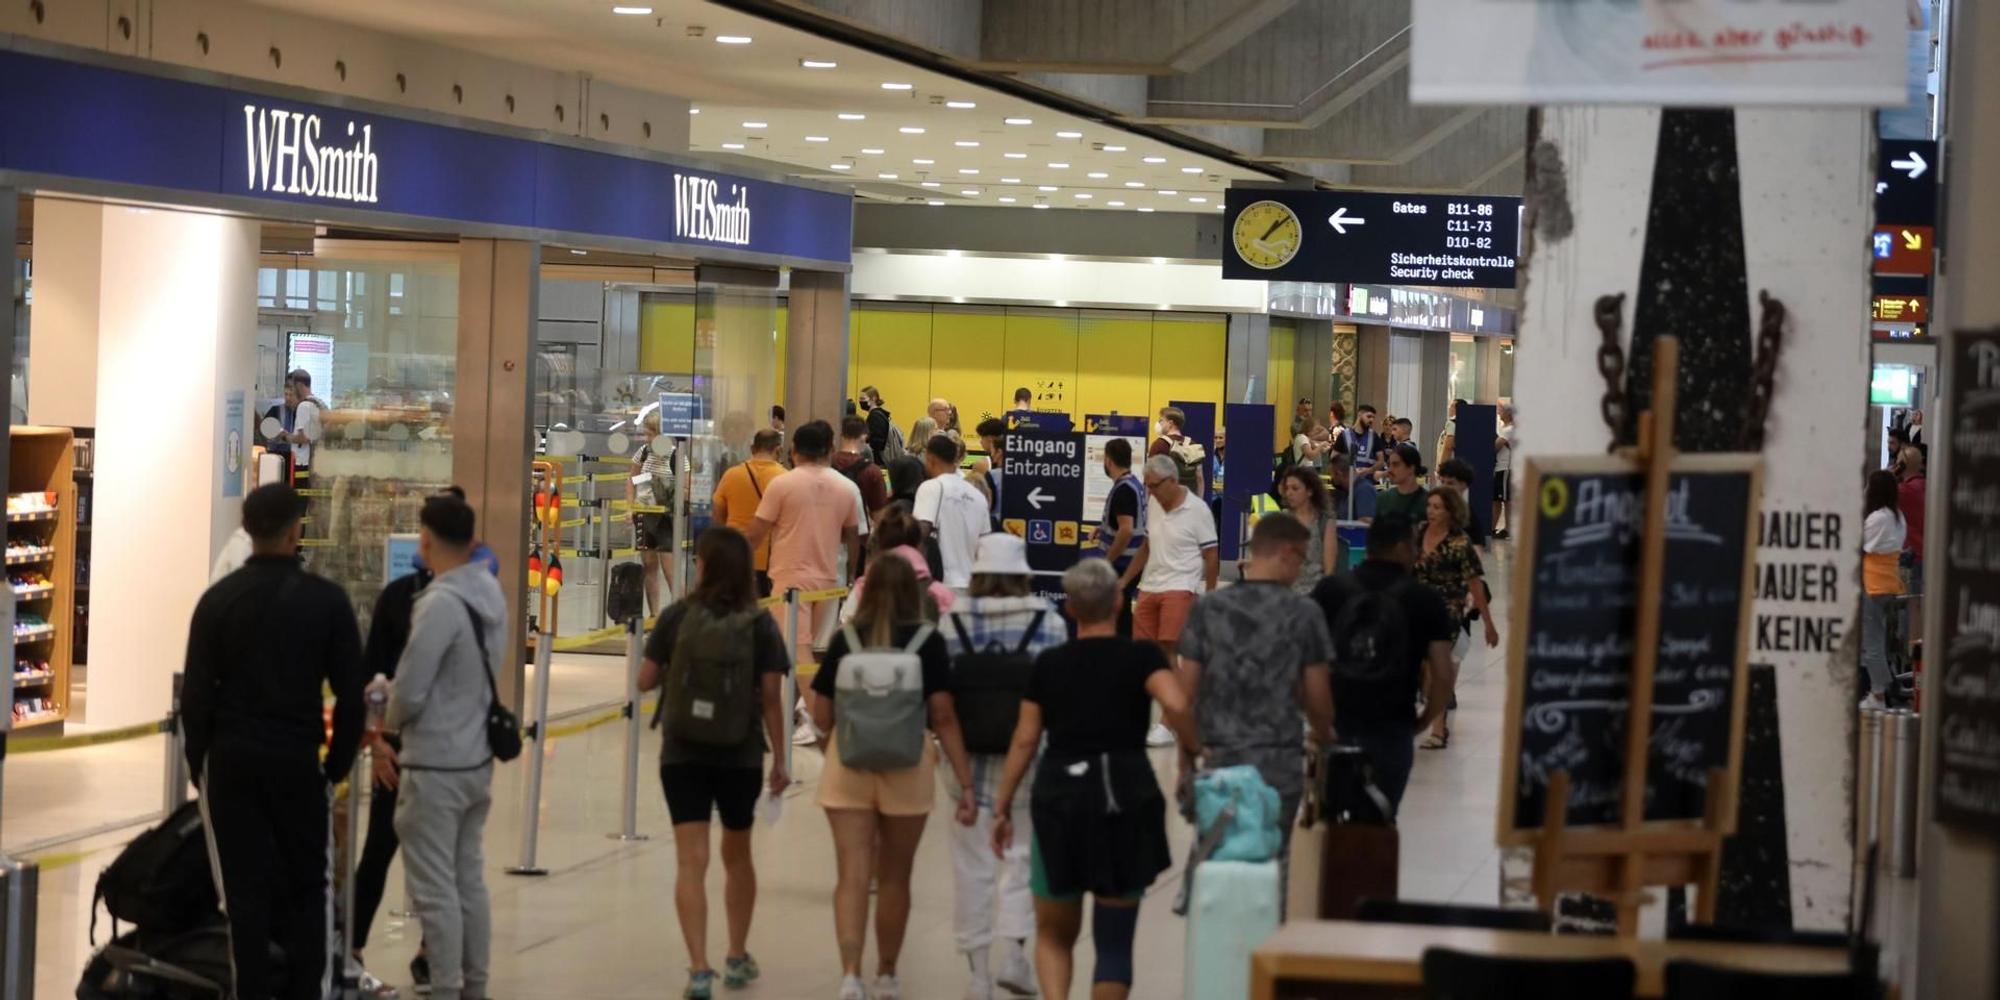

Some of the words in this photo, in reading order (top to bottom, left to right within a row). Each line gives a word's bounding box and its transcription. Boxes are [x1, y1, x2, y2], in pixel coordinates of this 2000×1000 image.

[244, 104, 378, 203] WHSmith
[674, 173, 750, 246] WHSmith
[1392, 201, 1427, 214] Gates
[1447, 203, 1493, 216] B11-86
[1447, 219, 1492, 232] C11-73
[1446, 236, 1491, 249] D10-82
[1390, 252, 1515, 268] Sicherheitskontrolle
[1390, 265, 1438, 280] Security
[1441, 268, 1475, 280] check
[1006, 434, 1076, 459] Eingang
[1005, 457, 1080, 478] Entrance
[1756, 613, 1843, 653] KEINE
